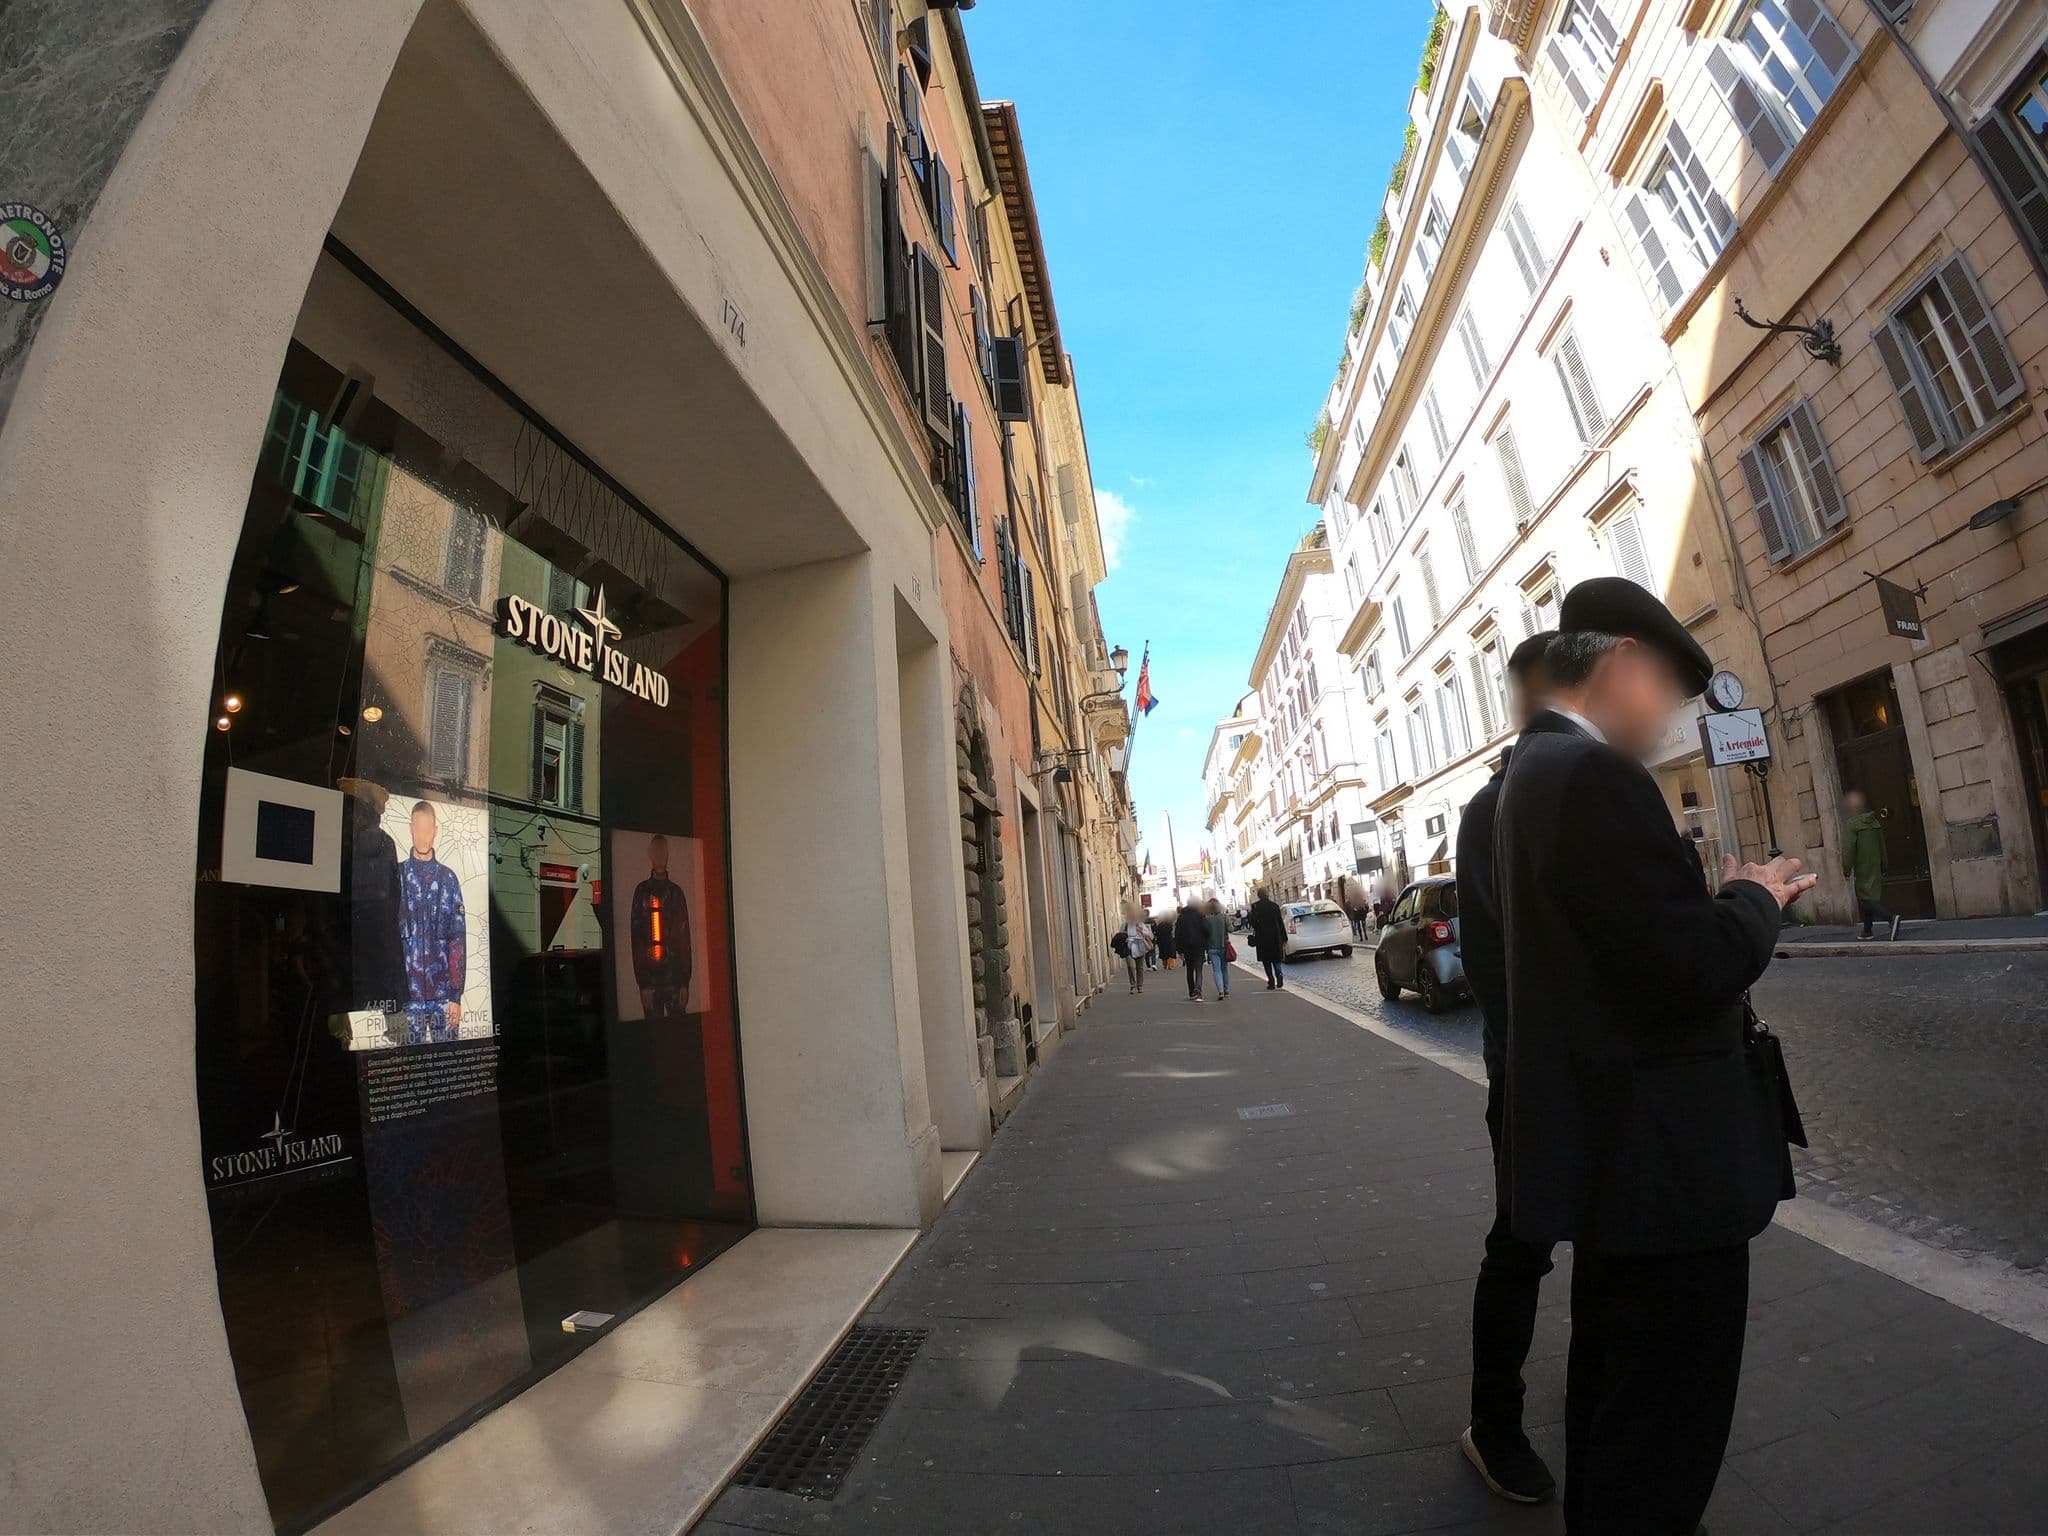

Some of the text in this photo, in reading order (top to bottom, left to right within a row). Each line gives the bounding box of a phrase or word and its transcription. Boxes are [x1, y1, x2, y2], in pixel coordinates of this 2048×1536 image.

[11, 287, 22, 299] di
[24, 282, 53, 300] Roma
[721, 297, 746, 348] 174
[1895, 620, 1920, 631] FRAU
[507, 594, 670, 708] STONE ISLAND
[212, 1134, 342, 1181] STONE ISLAND
